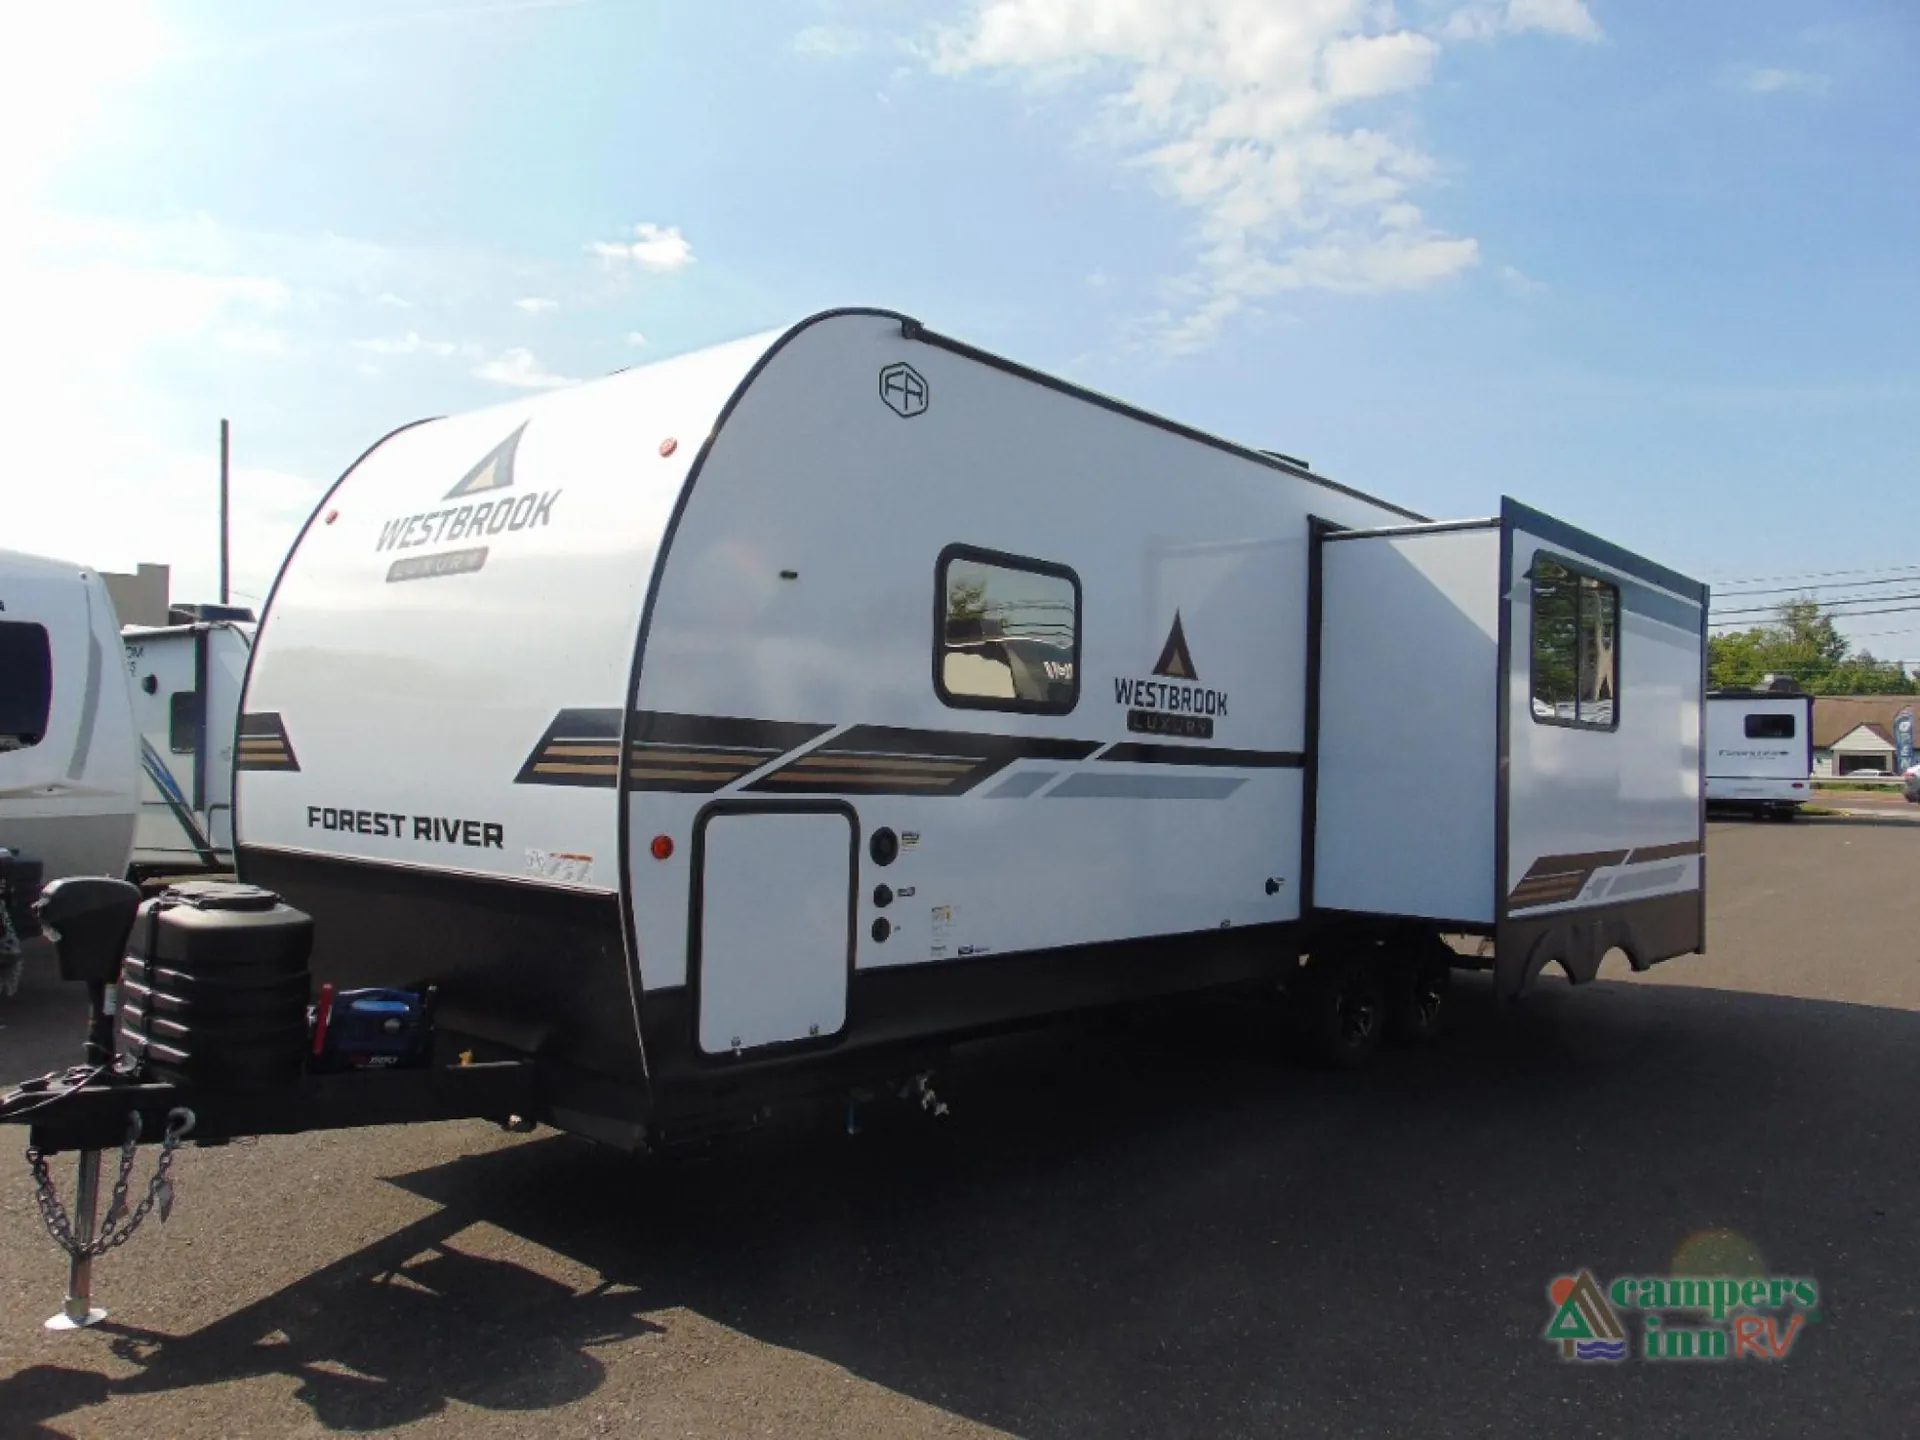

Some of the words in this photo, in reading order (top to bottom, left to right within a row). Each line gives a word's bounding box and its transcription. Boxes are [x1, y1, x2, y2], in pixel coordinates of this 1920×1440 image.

[375, 489, 563, 552] WESTBROOK
[1115, 678, 1228, 716] WESTBROOK
[307, 806, 406, 838] FOREST
[413, 816, 504, 849] RIVER
